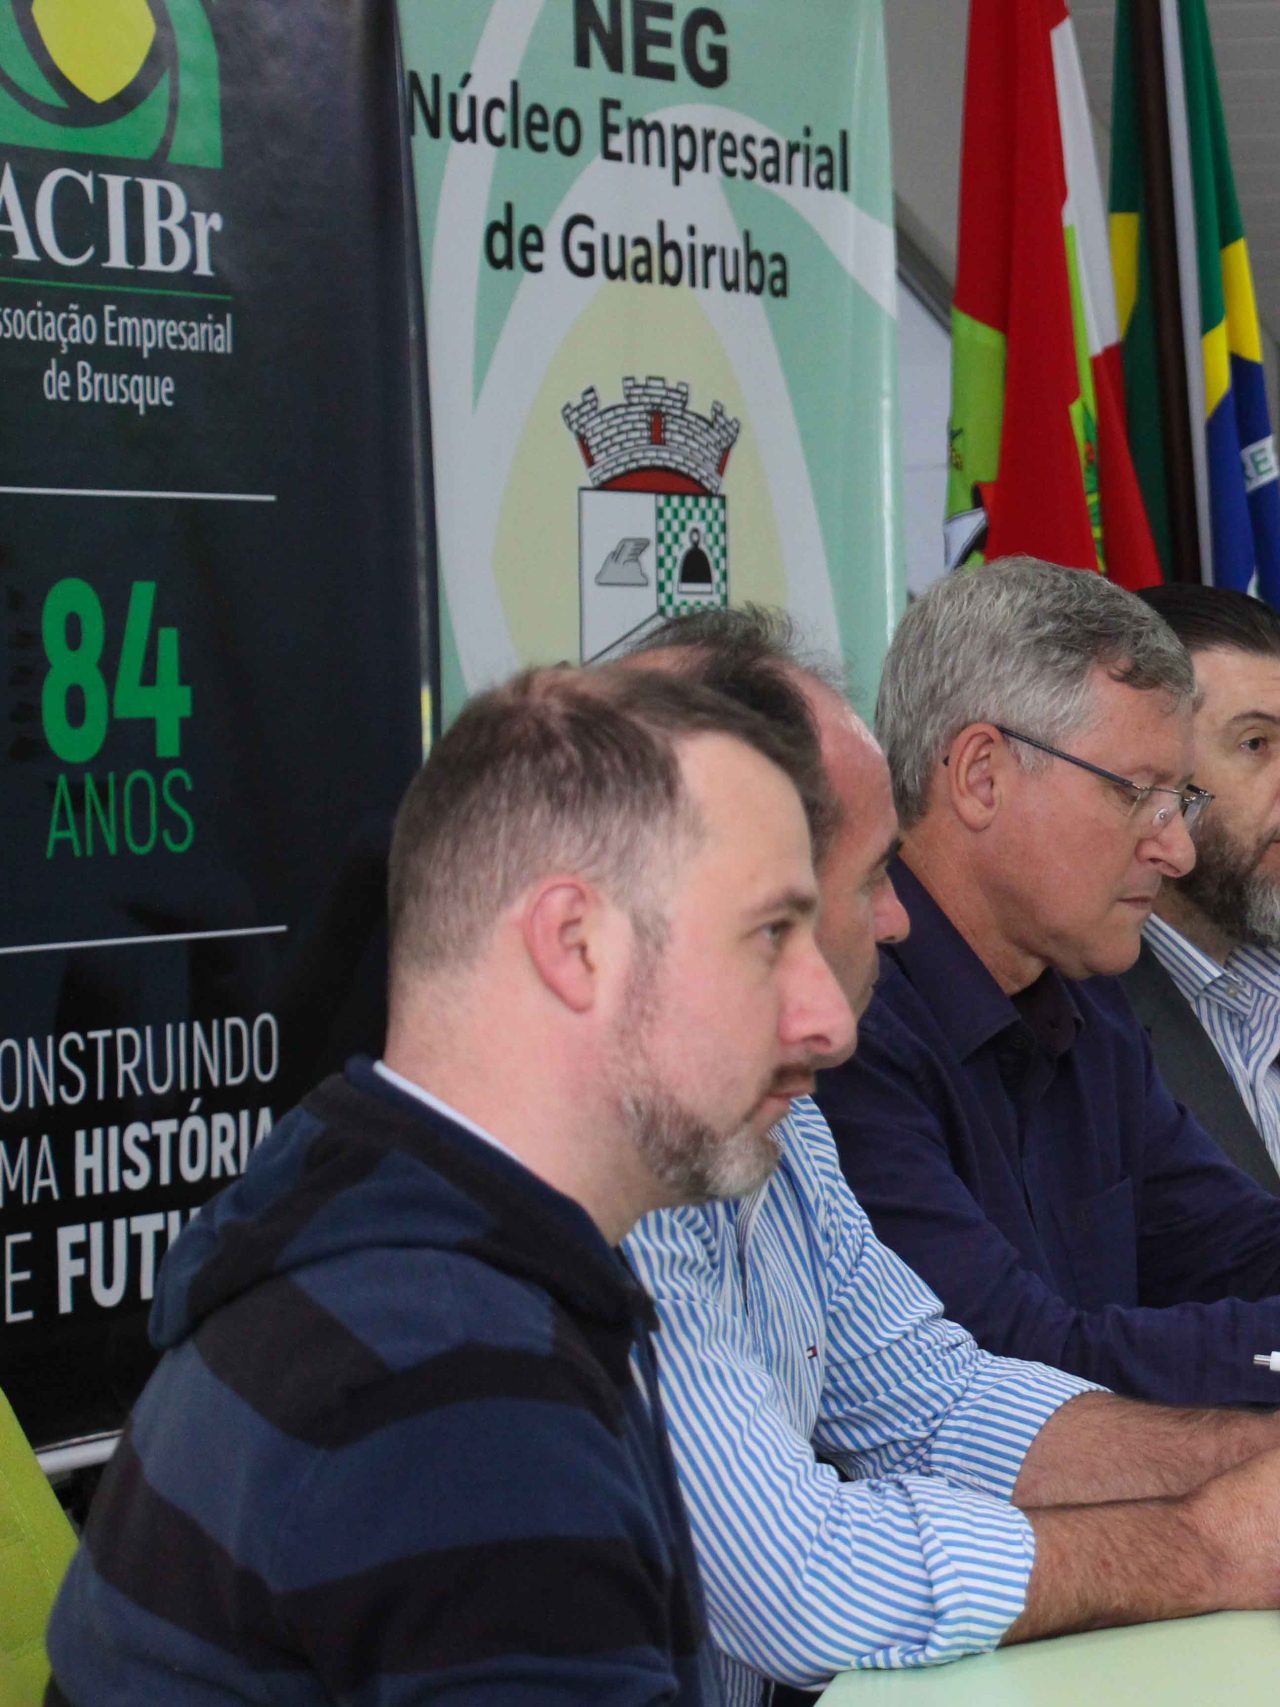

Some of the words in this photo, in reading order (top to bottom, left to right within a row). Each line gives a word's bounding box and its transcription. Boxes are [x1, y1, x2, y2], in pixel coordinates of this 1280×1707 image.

[574, 0, 729, 89] NEG
[408, 70, 583, 158] Núcleo
[600, 98, 850, 193] Empresarial
[0, 161, 224, 277] ACIBr
[485, 202, 544, 274] de
[562, 213, 789, 298] Guabiruba
[0, 300, 97, 355] sociação
[103, 304, 233, 358] Empresarial
[43, 358, 71, 401] de
[77, 360, 175, 415] Brusque
[41, 577, 193, 763] 84
[46, 768, 194, 859] ANOS
[0, 1012, 279, 1113] ONSTRUINDO
[0, 1134, 60, 1208] MA
[5, 1232, 34, 1323] E
